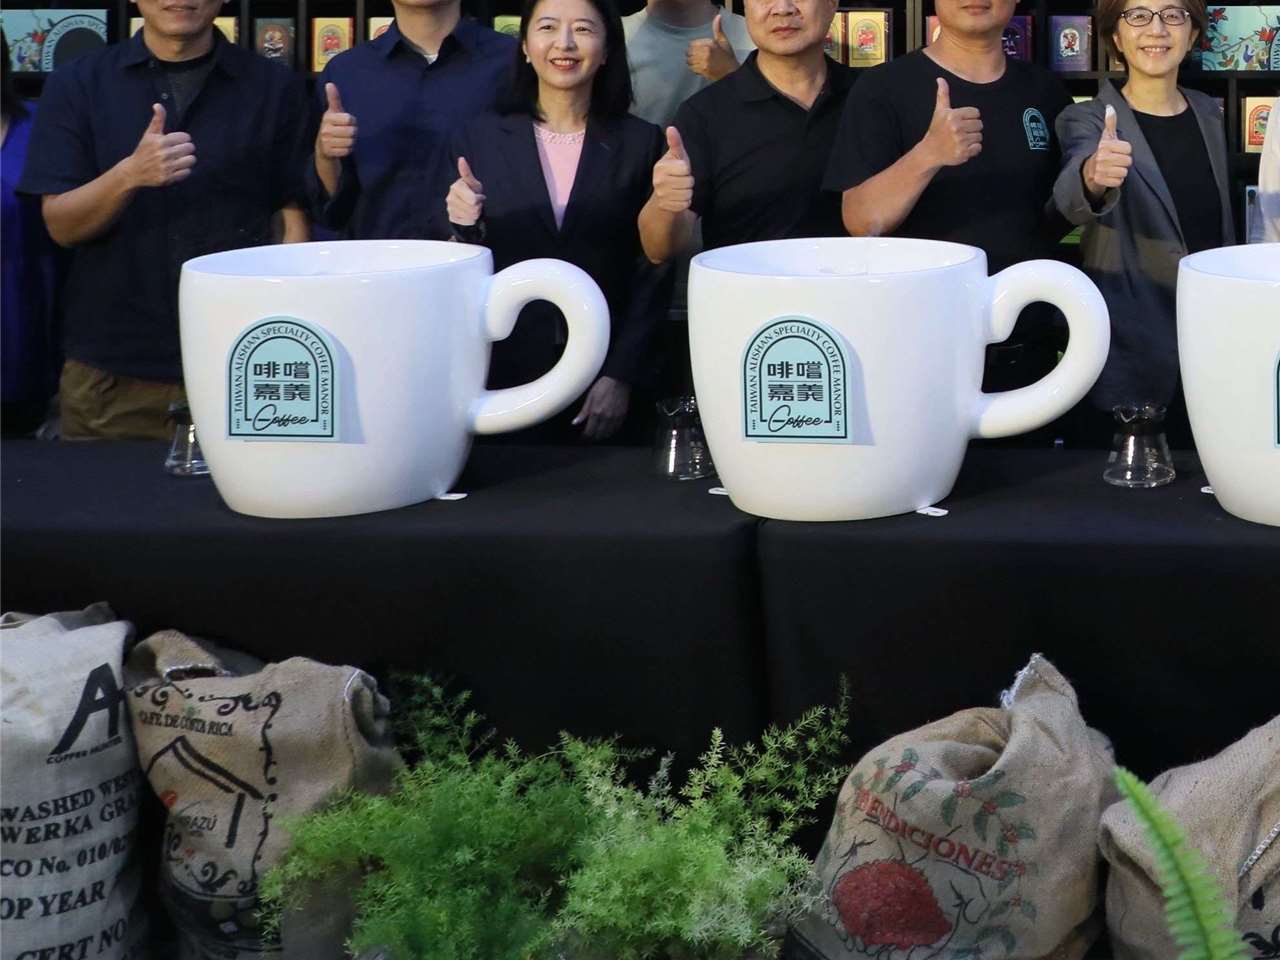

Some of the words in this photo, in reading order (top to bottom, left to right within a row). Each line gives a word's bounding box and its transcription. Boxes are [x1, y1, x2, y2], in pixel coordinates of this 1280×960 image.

[261, 326, 311, 341] SPECIALTY
[773, 325, 823, 341] SPECIALTY
[235, 334, 260, 372] ALISHAN
[310, 340, 329, 374] COFFEE
[750, 334, 773, 371] ALISHAN
[822, 340, 841, 374] COFFEE
[253, 361, 311, 379] 啡嚐
[767, 361, 823, 379] 啡嚐
[234, 375, 243, 413] TAIWAN
[253, 383, 311, 401] 嘉義
[321, 377, 329, 415] MANOR
[750, 375, 758, 413] TAIWAN
[767, 384, 824, 401] 嘉義
[832, 377, 842, 416] MANOR
[253, 404, 310, 431] Coffee
[768, 404, 824, 432] Coffee
[164, 713, 180, 728] DE
[180, 715, 207, 734] COSTA
[208, 720, 233, 736] RICA
[0, 788, 96, 823] WASHED
[0, 814, 94, 845] WERKA
[38, 879, 105, 917] YEAR
